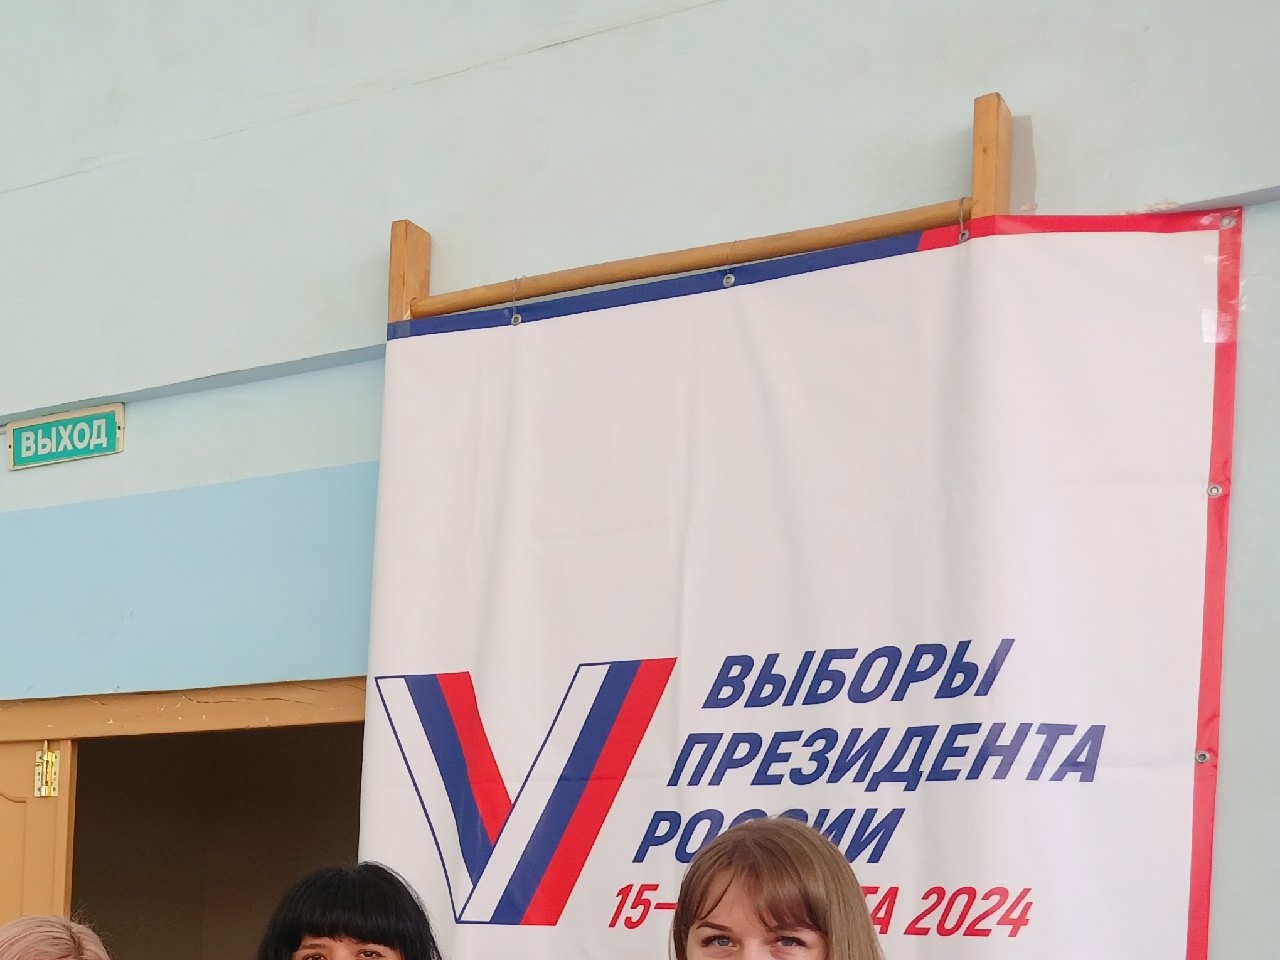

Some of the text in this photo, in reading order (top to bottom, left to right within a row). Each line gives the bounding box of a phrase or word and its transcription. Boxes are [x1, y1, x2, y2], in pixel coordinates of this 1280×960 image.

[21, 419, 108, 458] ВЫХОД
[701, 638, 1015, 710] ВЫБОРЫ
[666, 722, 1107, 792] ПРЕЗИДЕНТА
[632, 808, 906, 864] РОИИ
[904, 886, 1032, 938] 2024
